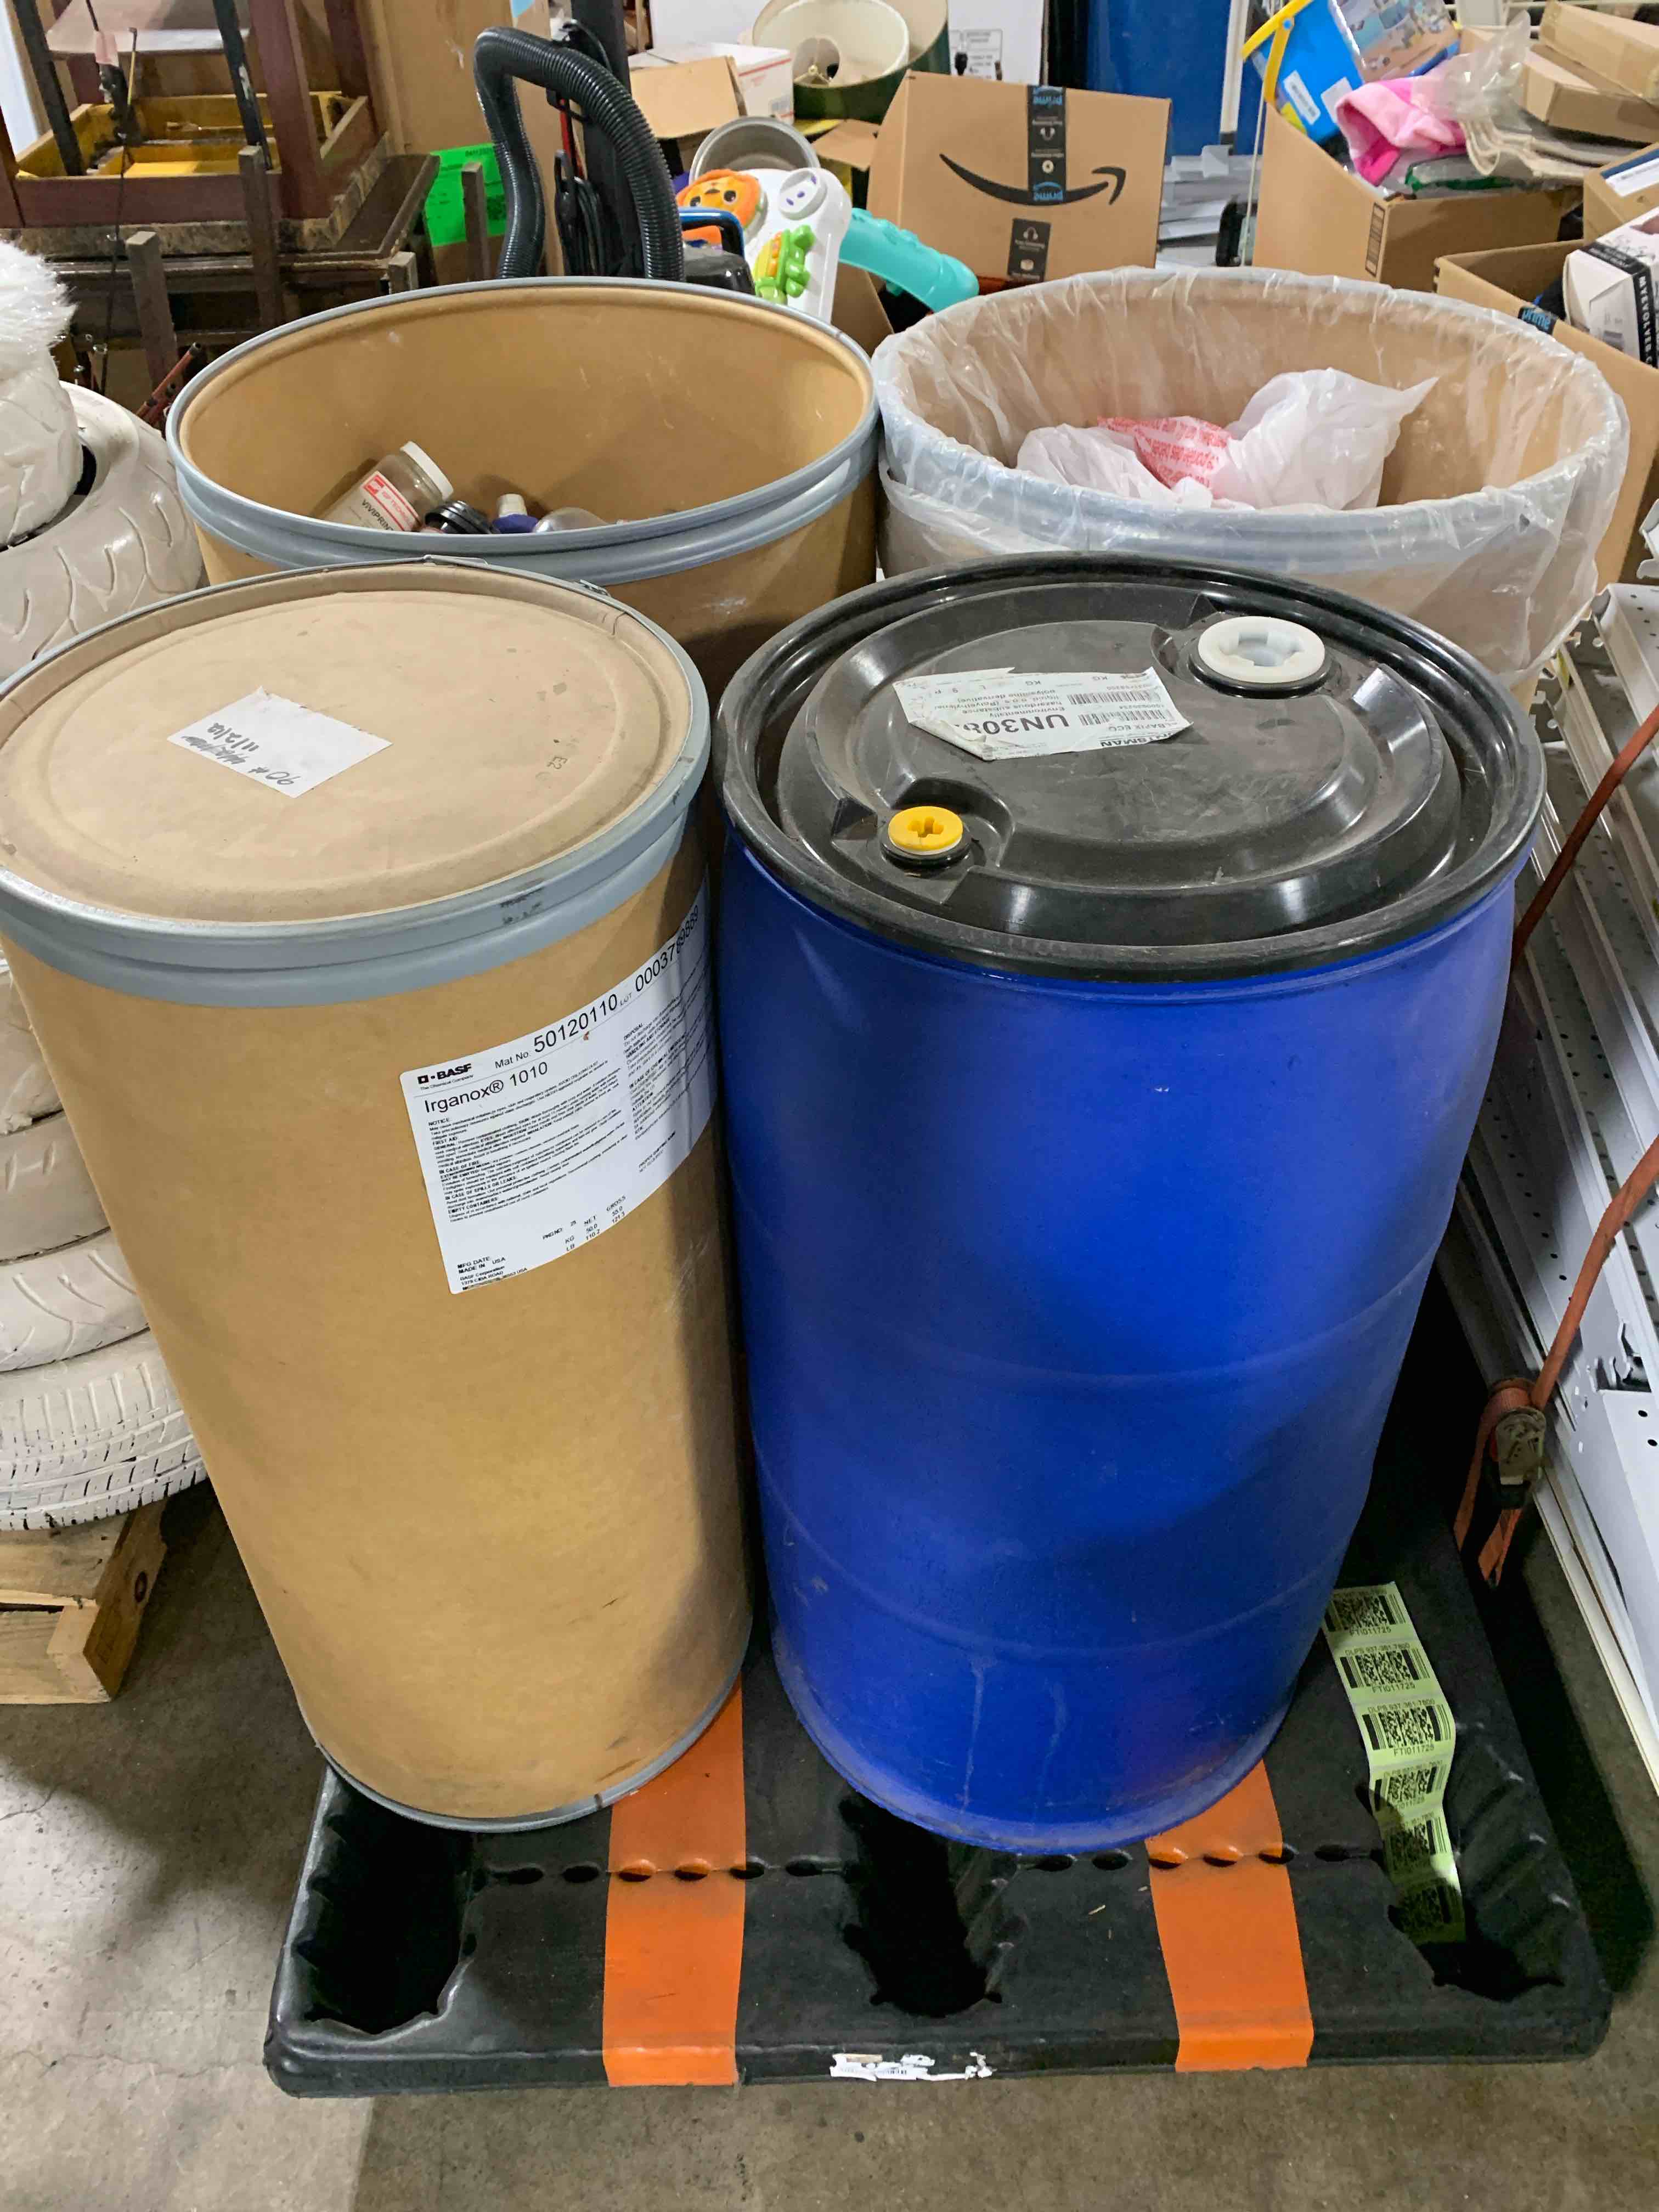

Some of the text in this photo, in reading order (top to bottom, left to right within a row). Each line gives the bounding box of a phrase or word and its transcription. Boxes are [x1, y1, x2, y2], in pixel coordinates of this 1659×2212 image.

[954, 714, 1069, 735] UN308
[437, 1063, 472, 1080] BASF
[494, 1057, 514, 1069] Mat
[534, 993, 618, 1053] 50120110
[509, 1062, 548, 1087] 1010
[606, 1194, 627, 1212] GROSS
[458, 1266, 478, 1274] MADE
[492, 1256, 506, 1265] USA
